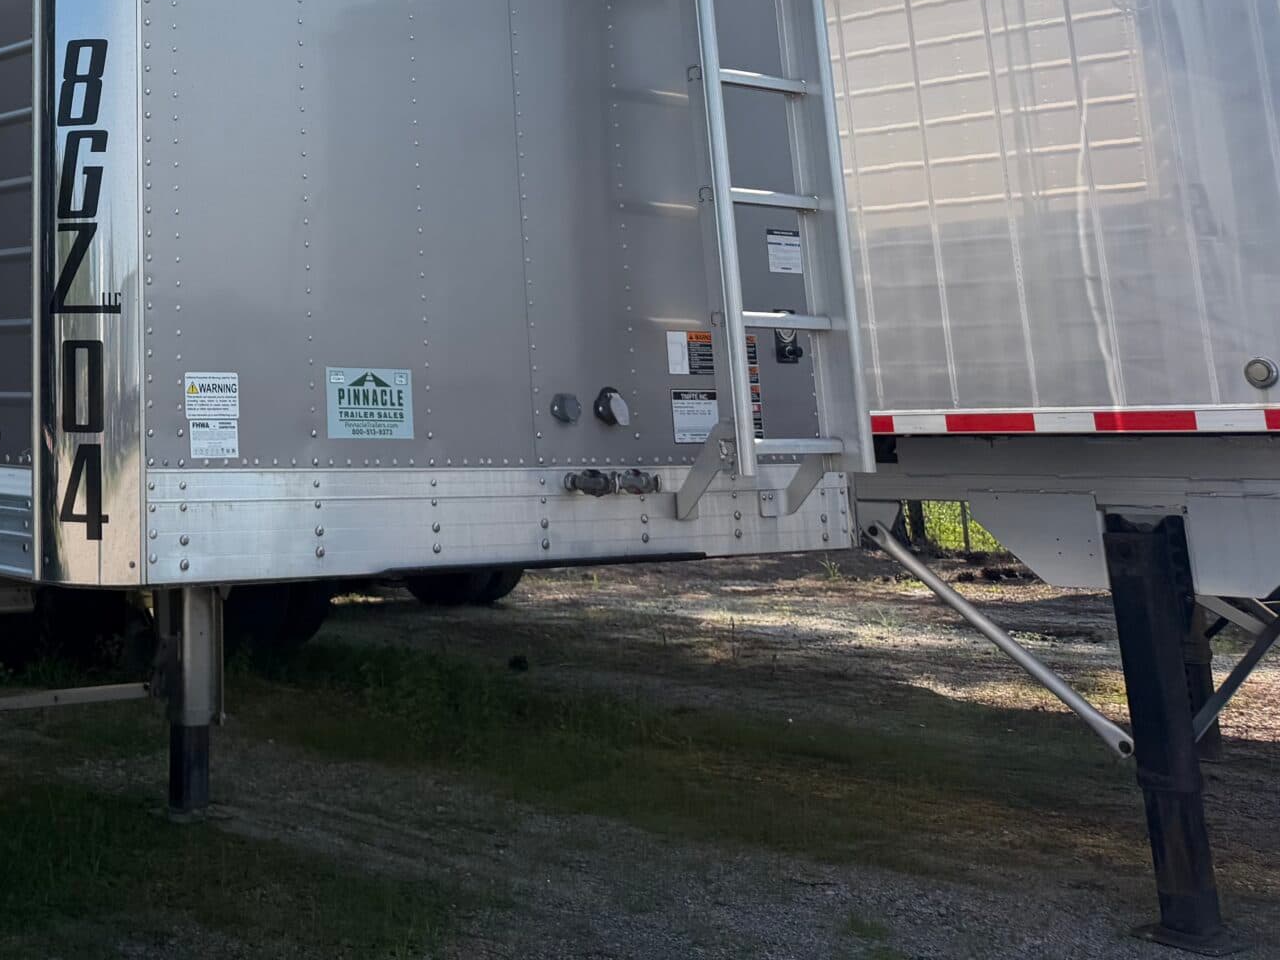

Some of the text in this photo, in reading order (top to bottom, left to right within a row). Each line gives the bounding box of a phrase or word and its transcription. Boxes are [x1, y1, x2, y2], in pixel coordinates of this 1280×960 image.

[199, 383, 237, 393] WARNING
[337, 388, 405, 407] PINNACLE
[338, 410, 405, 419] TRAILER SALES
[351, 428, 393, 436] 800-513-9373
[59, 340, 110, 541] 04
